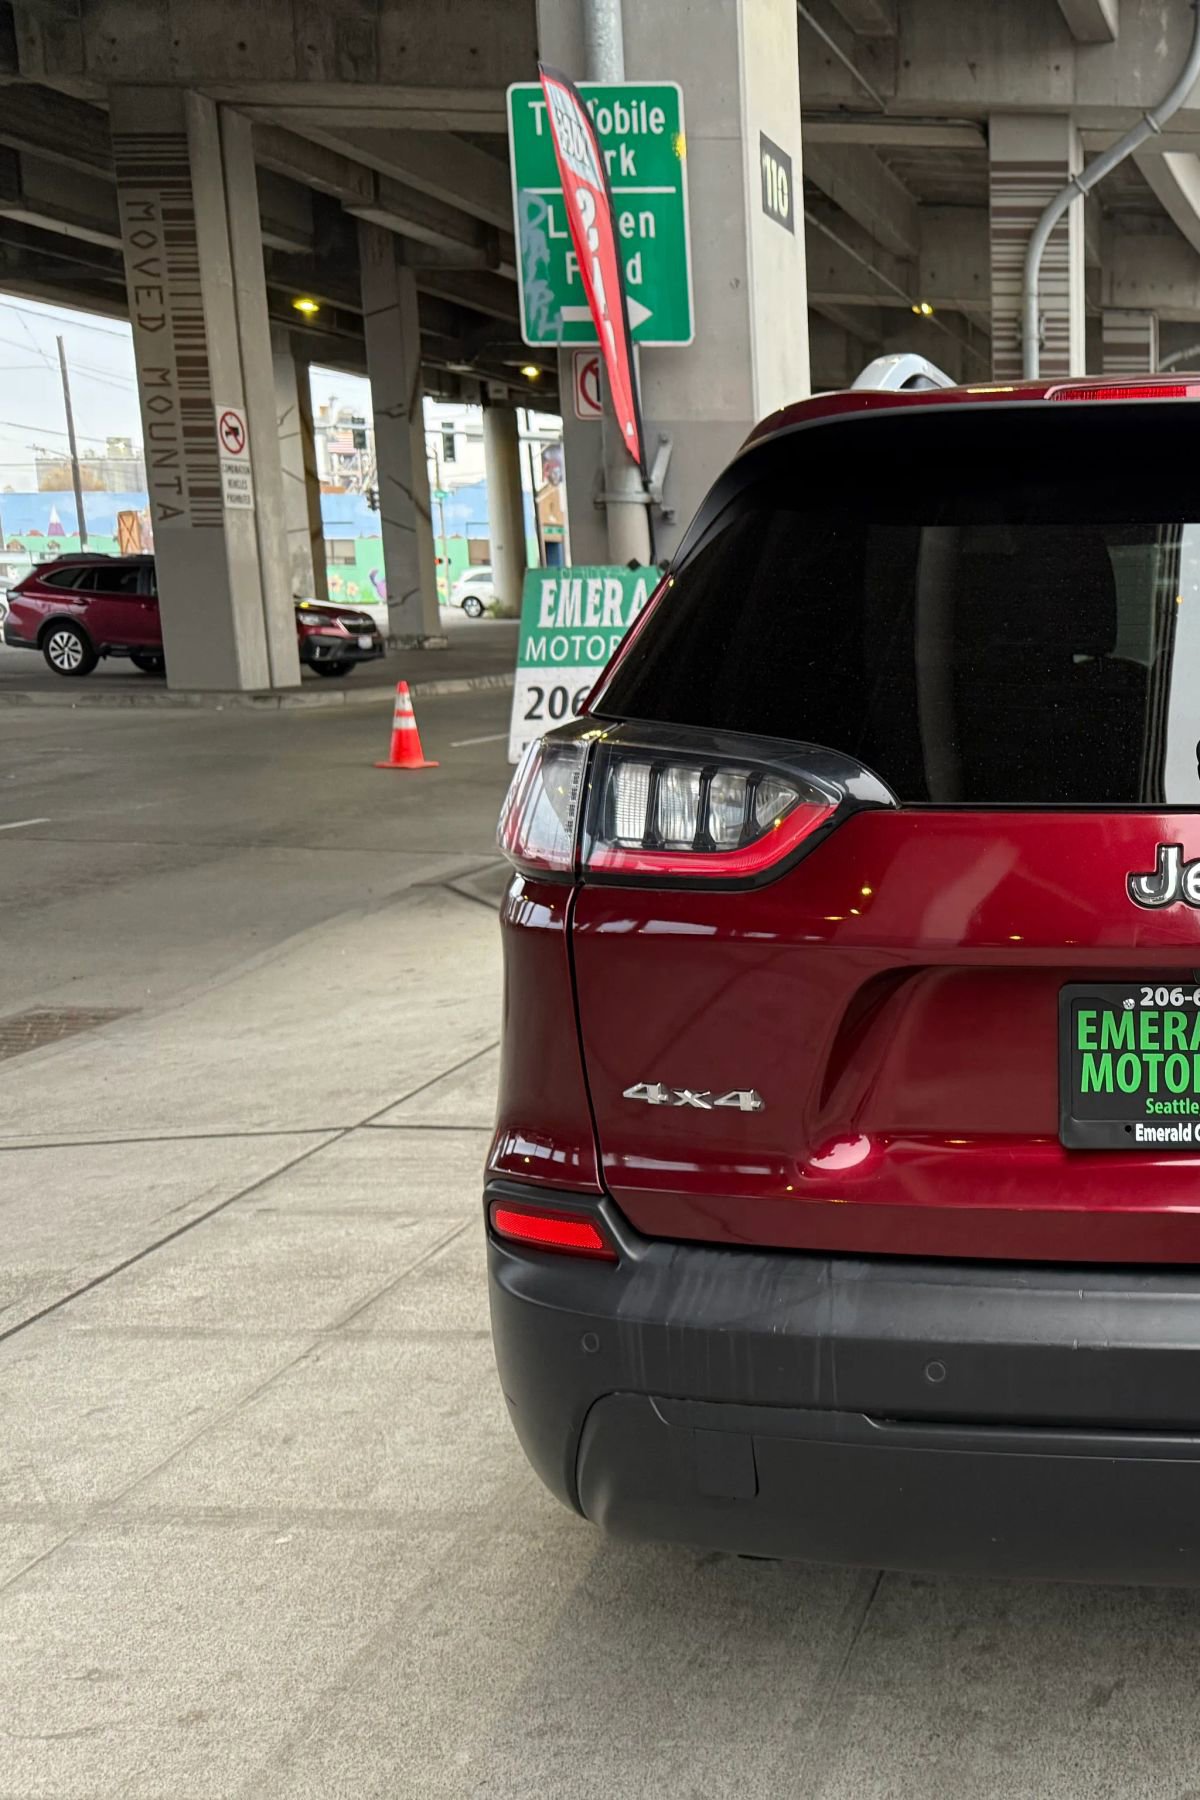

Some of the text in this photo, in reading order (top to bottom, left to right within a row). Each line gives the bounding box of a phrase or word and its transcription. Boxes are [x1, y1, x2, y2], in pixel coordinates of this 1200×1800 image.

[527, 98, 665, 136] Tobile
[762, 150, 789, 219] 110
[547, 204, 656, 238] Len
[125, 201, 185, 521] MOVED MOUNTA
[537, 577, 652, 628] EMERA
[1135, 1123, 1193, 1142] Emerald
